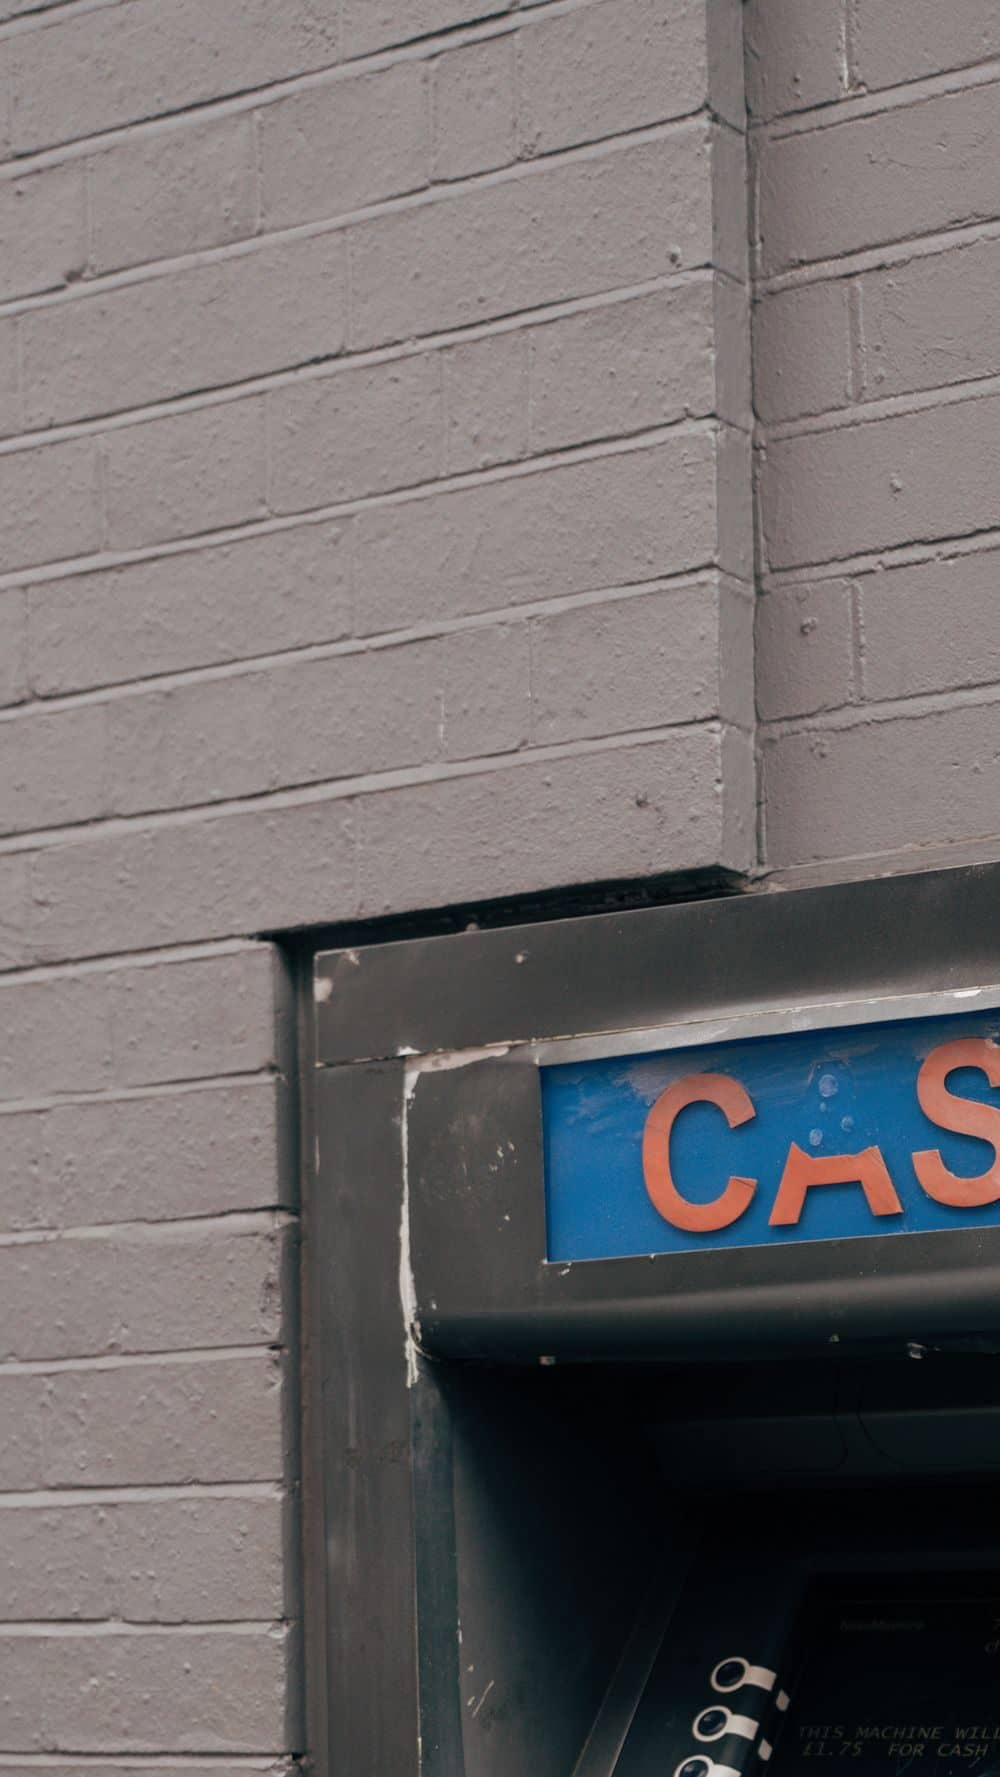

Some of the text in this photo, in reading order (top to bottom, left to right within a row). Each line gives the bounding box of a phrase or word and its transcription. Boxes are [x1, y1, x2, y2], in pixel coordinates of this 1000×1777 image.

[799, 1725, 844, 1740] THIS
[856, 1725, 944, 1740] MACHINE
[802, 1743, 863, 1757] £1.75
[888, 1743, 925, 1757] FOR
[938, 1743, 988, 1758] CASH
